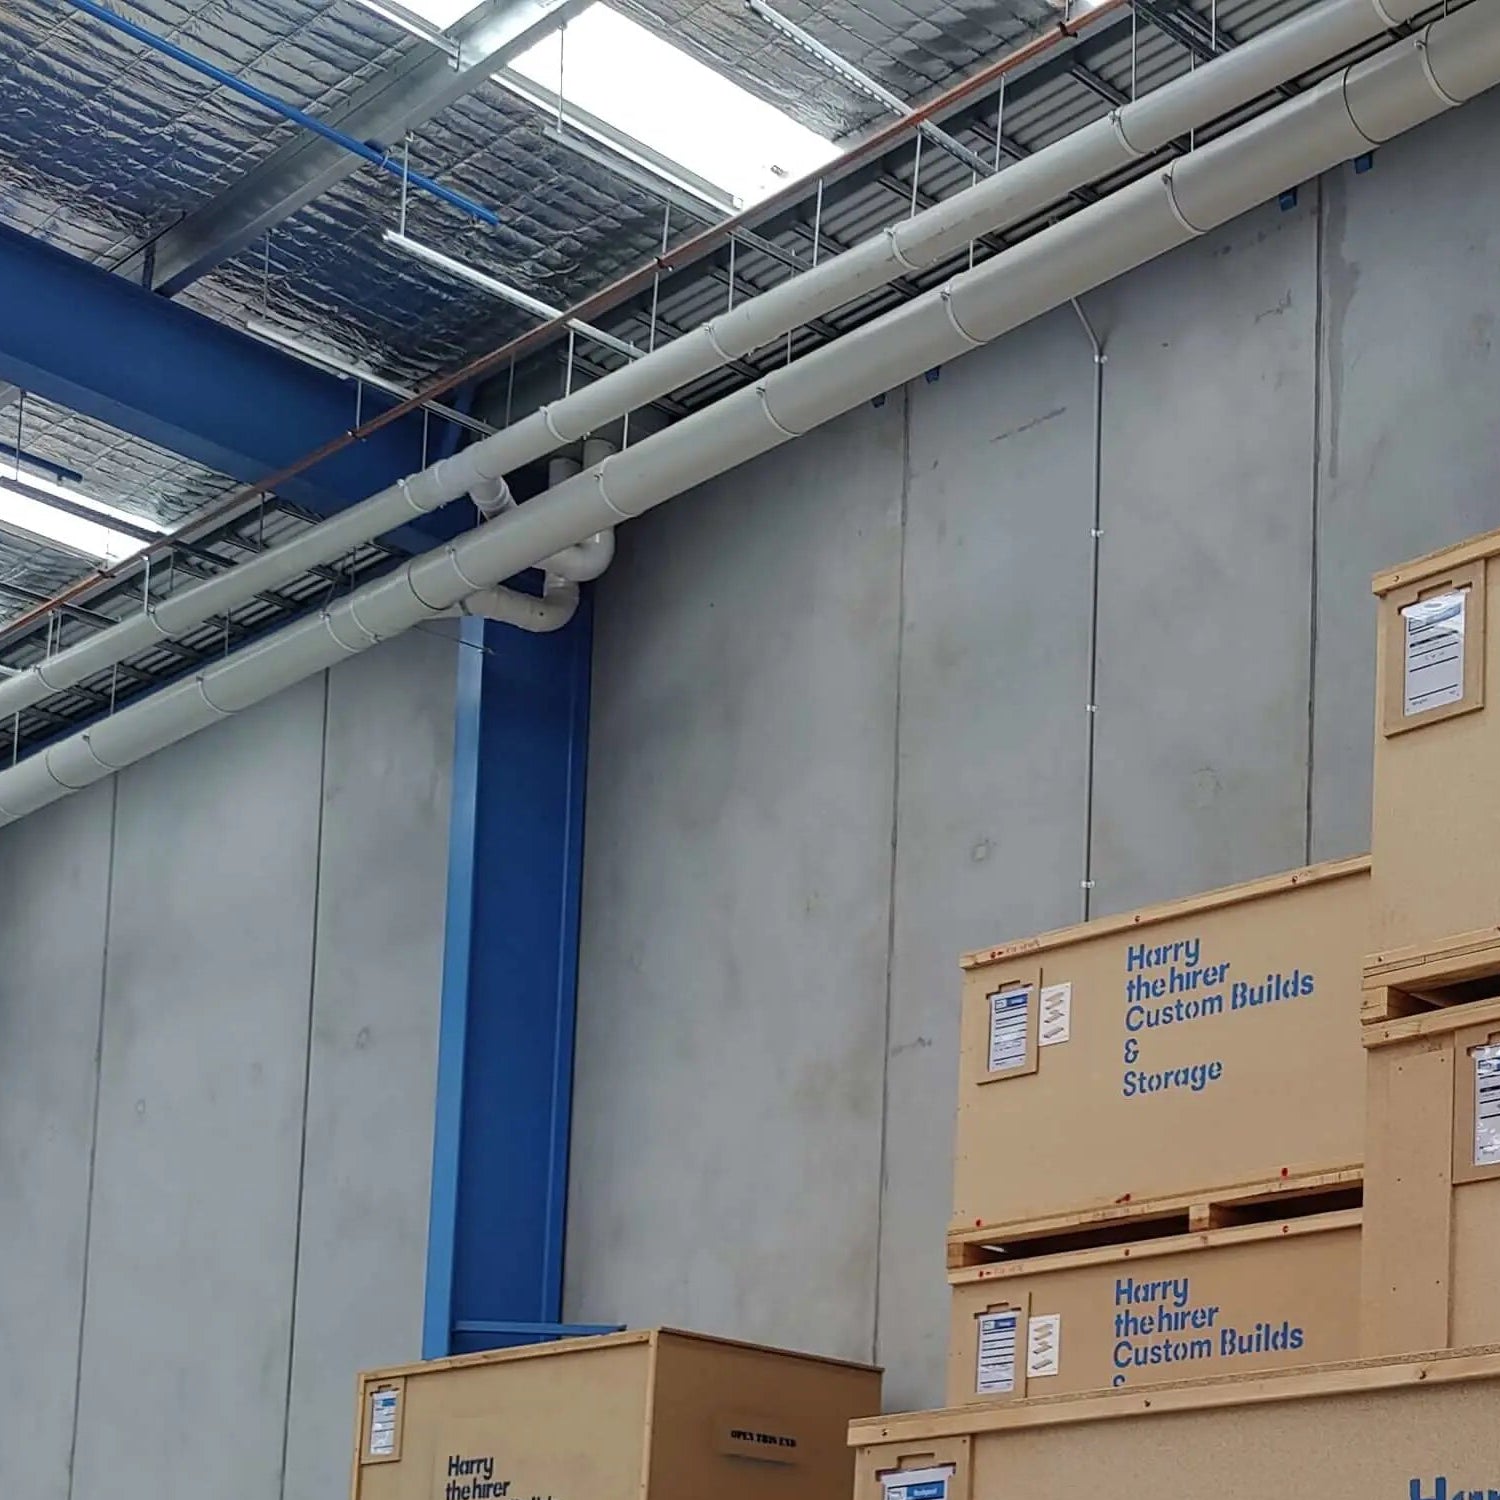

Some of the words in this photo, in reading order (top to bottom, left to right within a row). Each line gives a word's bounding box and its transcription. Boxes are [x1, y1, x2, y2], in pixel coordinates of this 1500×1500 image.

[1127, 937, 1200, 973] Harry
[1126, 993, 1224, 1032] Custom
[1232, 970, 1314, 1010] Builds
[1123, 1039, 1139, 1063] &
[1122, 1059, 1223, 1097] Storage
[1115, 1277, 1189, 1308] Harry
[1113, 1333, 1212, 1369] Custom
[1220, 1323, 1304, 1357] Builds
[730, 1430, 754, 1441] OPEN
[448, 1456, 493, 1480] Harry
